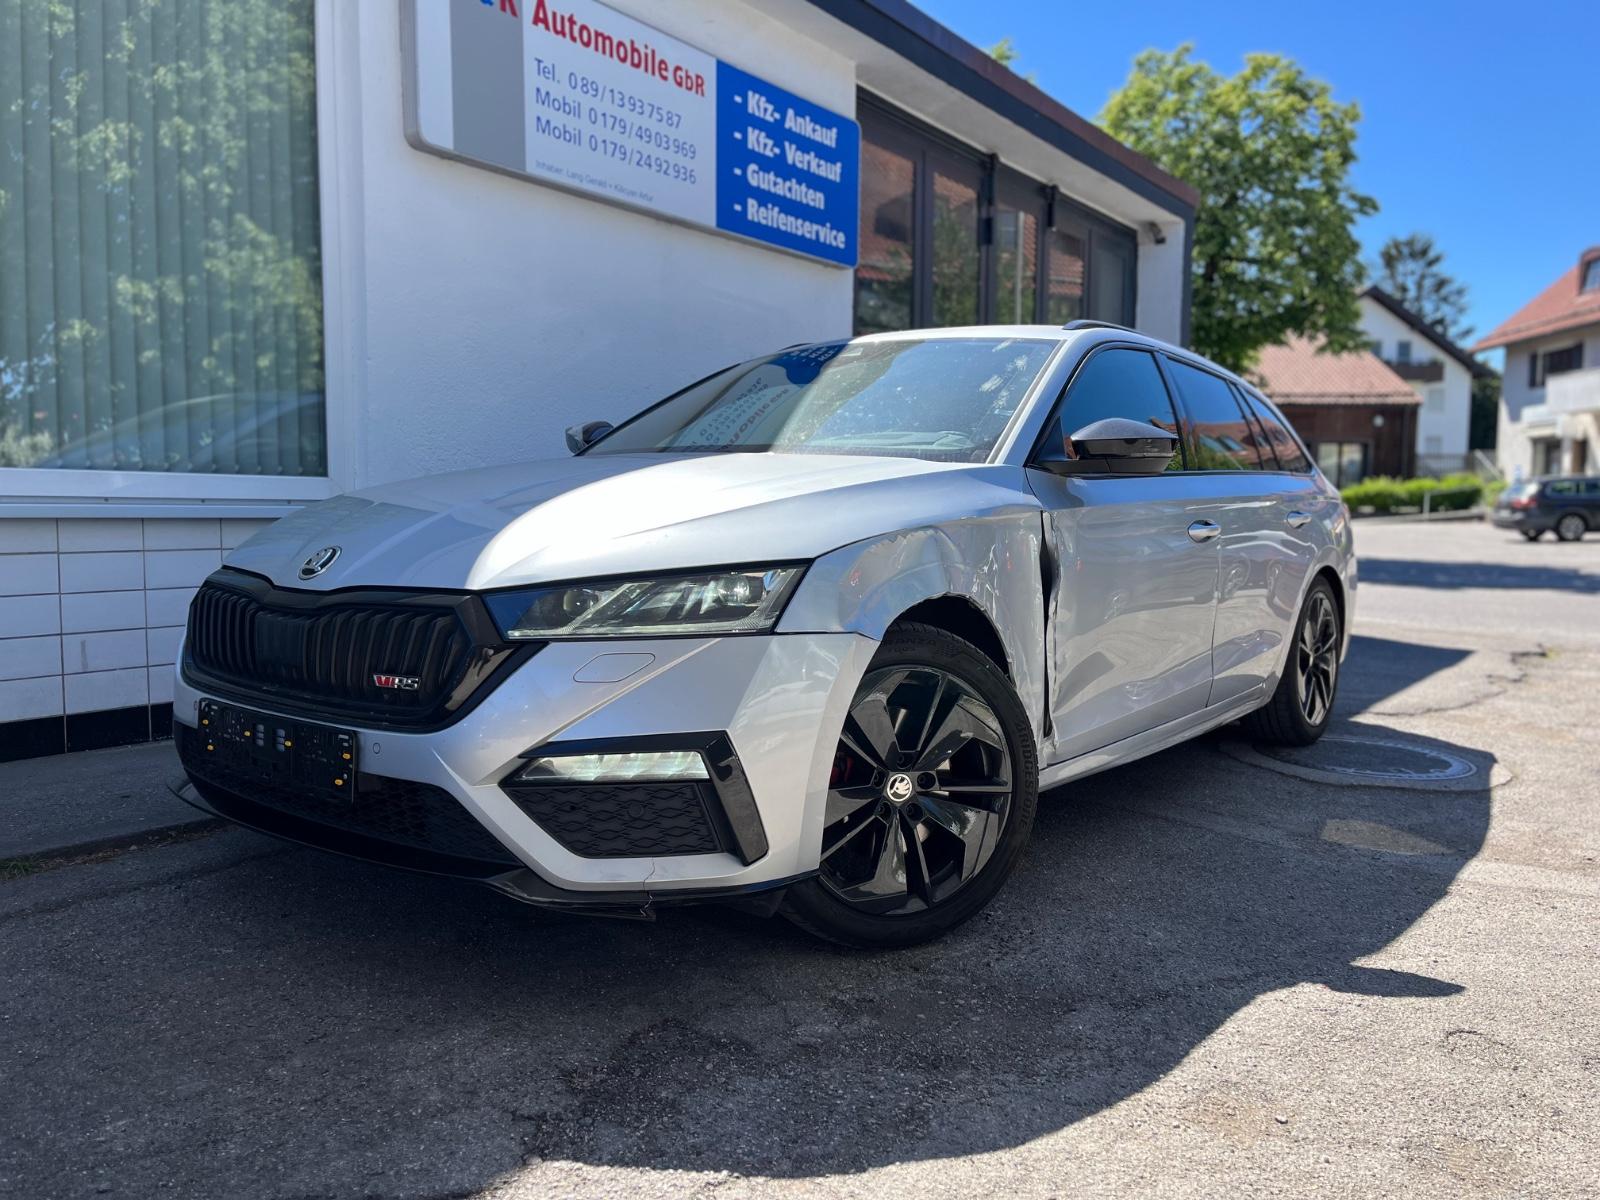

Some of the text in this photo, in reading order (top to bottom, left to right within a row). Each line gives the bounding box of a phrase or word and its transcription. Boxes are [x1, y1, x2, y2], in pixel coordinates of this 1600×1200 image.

[532, 0, 705, 97] Automobile GbR
[534, 57, 560, 84] Tel.
[535, 87, 581, 119] Mobil
[535, 115, 582, 147] Mobil
[784, 108, 838, 148] Ankauf
[784, 141, 842, 183] Verkauf
[747, 163, 825, 210] Gutachten
[747, 197, 846, 249] Reifenservice
